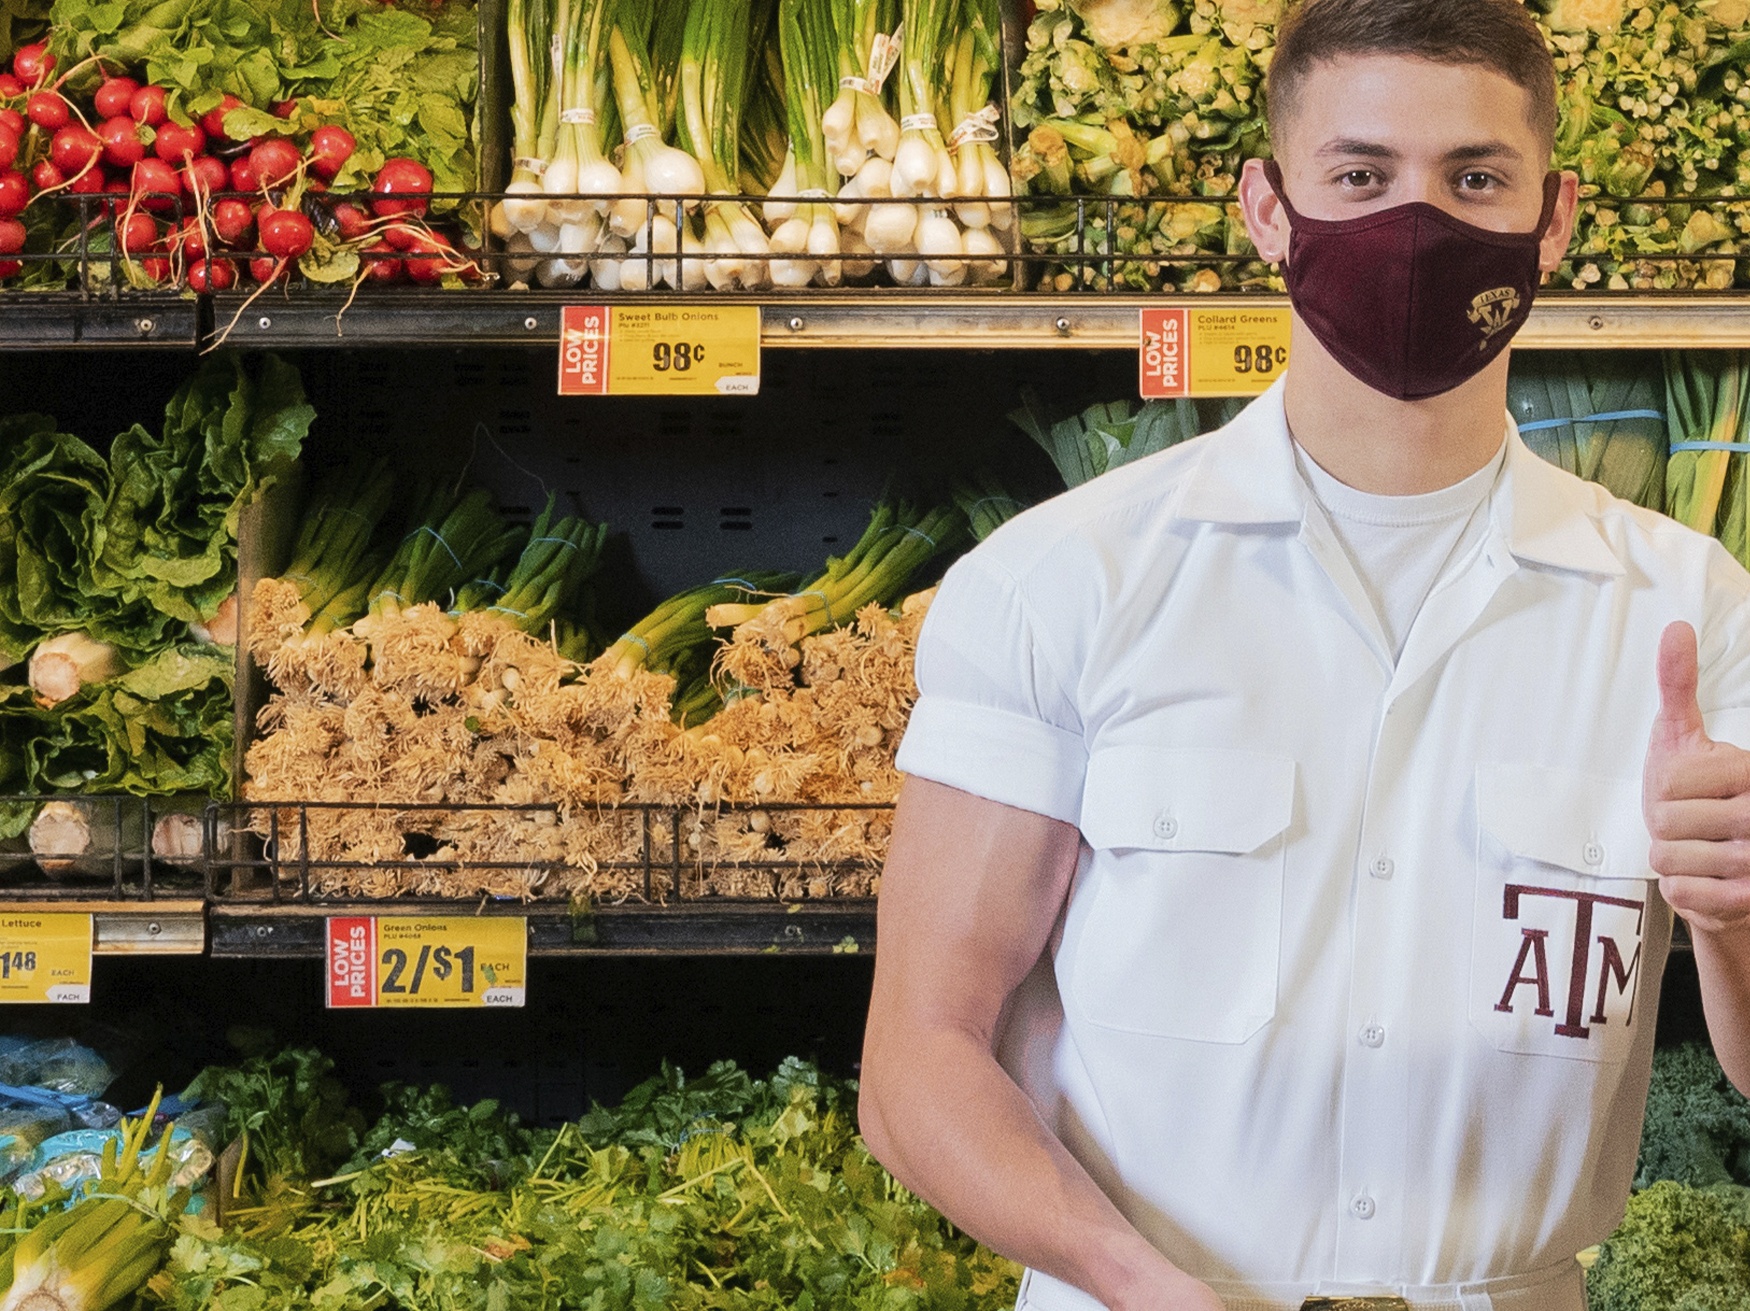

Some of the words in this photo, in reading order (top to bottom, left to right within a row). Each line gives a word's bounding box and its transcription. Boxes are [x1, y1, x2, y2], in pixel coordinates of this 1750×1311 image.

[1479, 289, 1511, 304] TEXAS
[618, 312, 651, 321] Sweet
[655, 312, 679, 321] Bulb
[682, 312, 719, 321] Onions
[1198, 314, 1236, 324] Collard
[1240, 314, 1278, 323] Greens
[565, 328, 583, 375] LOW
[581, 315, 600, 385] PRICES
[653, 342, 705, 372] 98¢
[1145, 330, 1162, 377] LOW
[1162, 318, 1179, 388] PRICES
[1234, 344, 1287, 373] 98¢
[1, 918, 42, 928] Lettuce
[384, 924, 412, 932] Green
[414, 923, 447, 931] Onions
[333, 937, 350, 987] LOW
[350, 925, 366, 998] PRICES
[381, 944, 475, 994] 2/$1
[480, 963, 510, 971] EACH
[486, 995, 513, 1003] EACH
